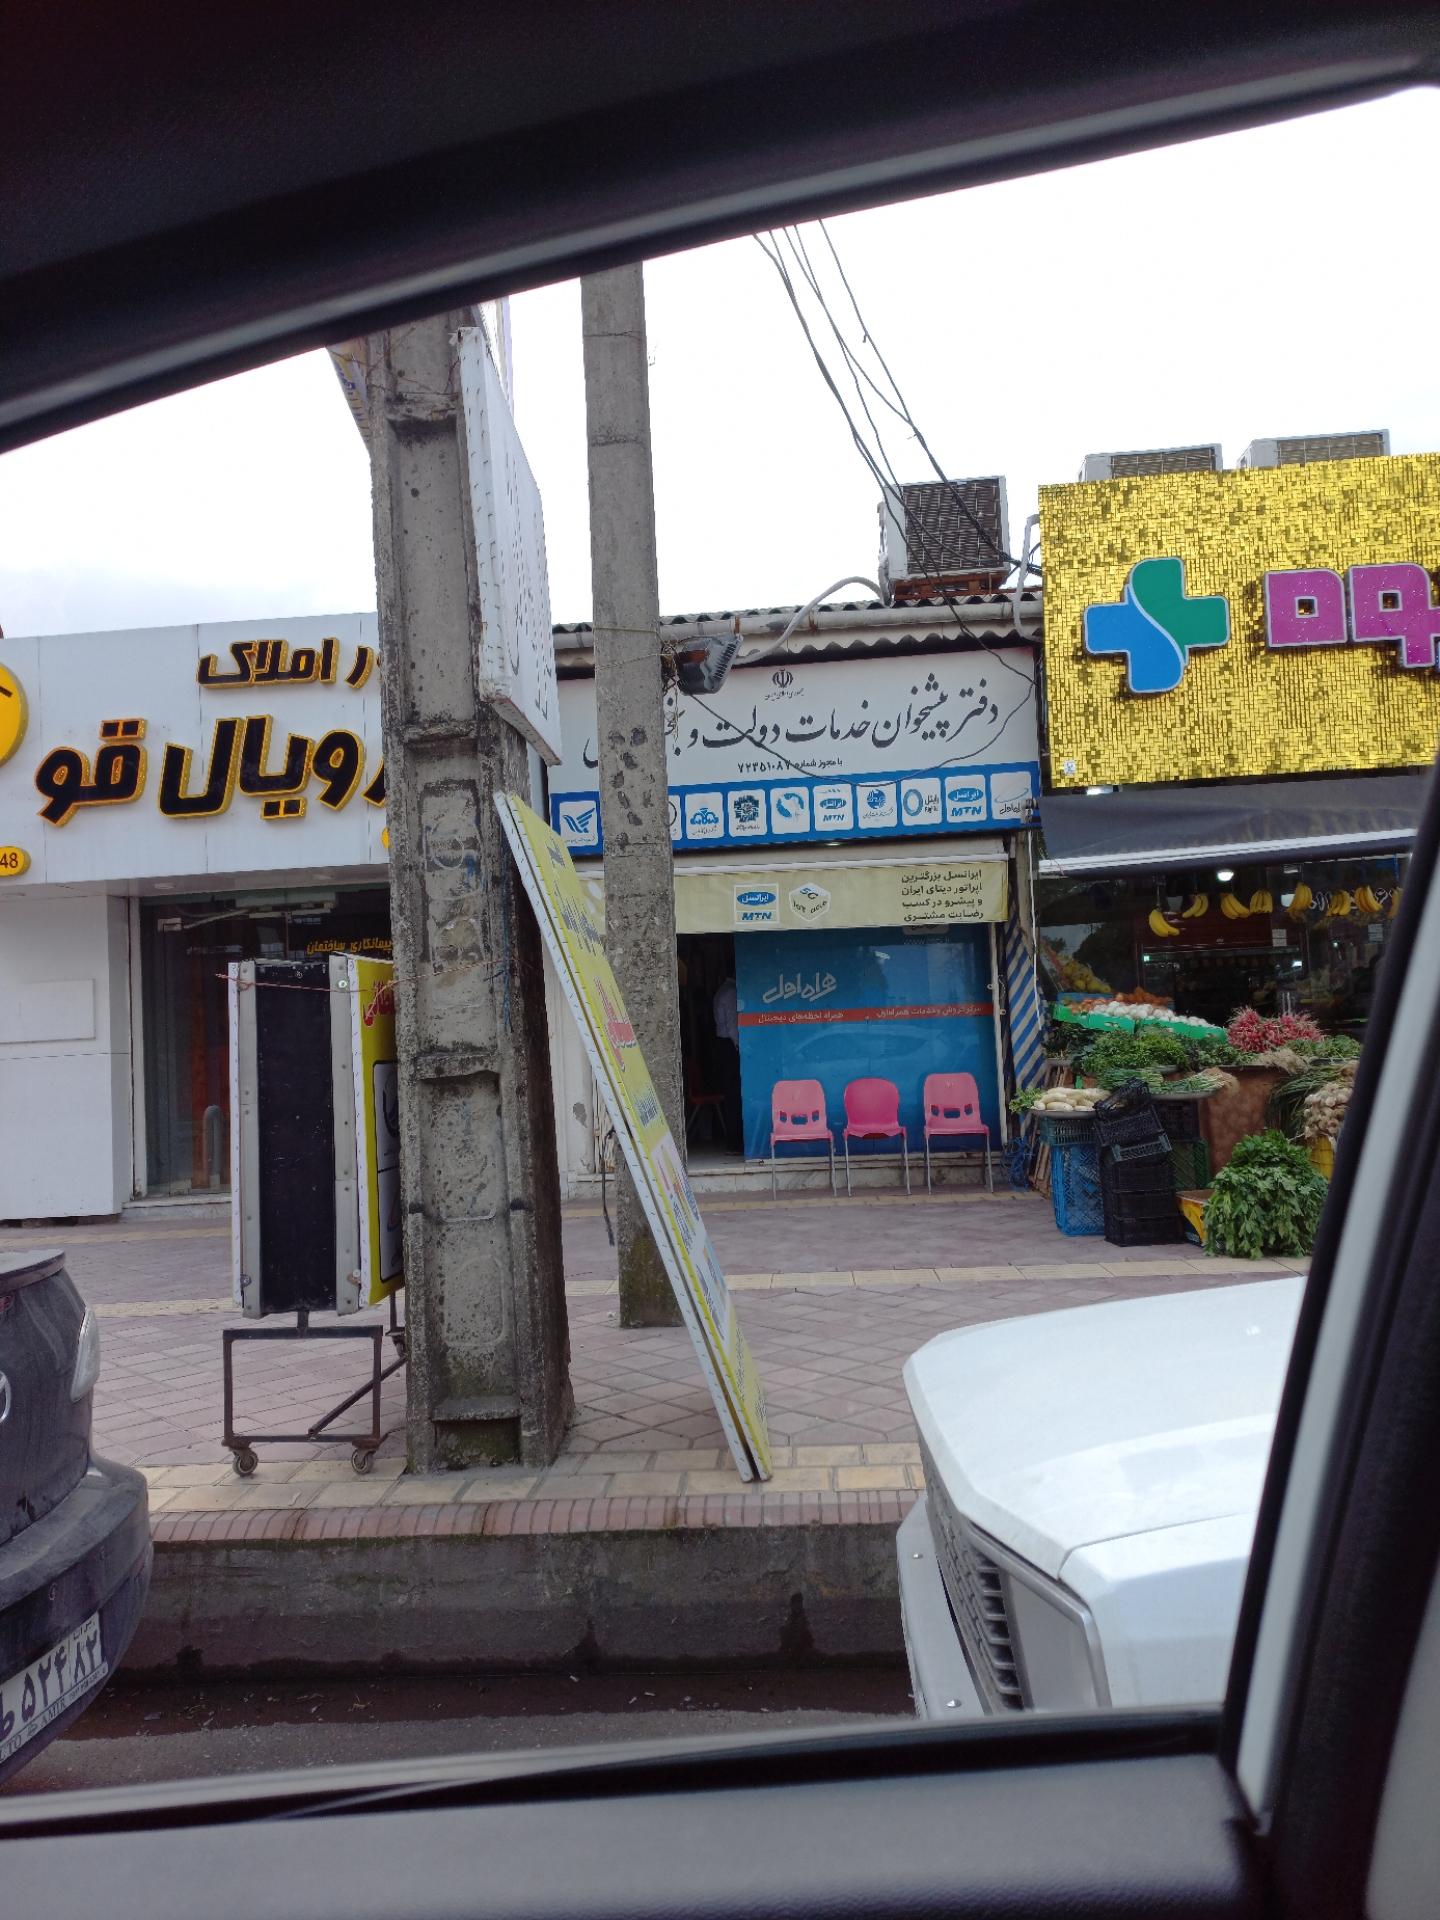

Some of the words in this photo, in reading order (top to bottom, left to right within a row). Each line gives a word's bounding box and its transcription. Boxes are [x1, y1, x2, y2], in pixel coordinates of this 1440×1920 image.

[197, 637, 339, 690] املاک
[872, 673, 949, 748] پیشخوان
[946, 678, 999, 743] دفتر
[703, 705, 781, 748] دولت
[786, 700, 871, 742] خدمات
[687, 728, 699, 749] و
[34, 718, 148, 827] قو
[951, 806, 982, 817] MTN
[823, 814, 845, 822] MTN
[901, 870, 941, 884] بزرگترین
[943, 869, 982, 882] ایرانسل
[800, 887, 819, 900] 5G
[901, 885, 924, 896] ایران
[926, 886, 952, 895] دیتای
[953, 882, 982, 895] اپراتور
[741, 893, 769, 903] ایرانسل
[902, 898, 931, 908] کسب
[932, 898, 942, 908] در
[944, 897, 975, 909] پیشرو
[741, 911, 772, 921] MTN
[903, 911, 946, 922] مشتری
[948, 909, 984, 920] رضایت
